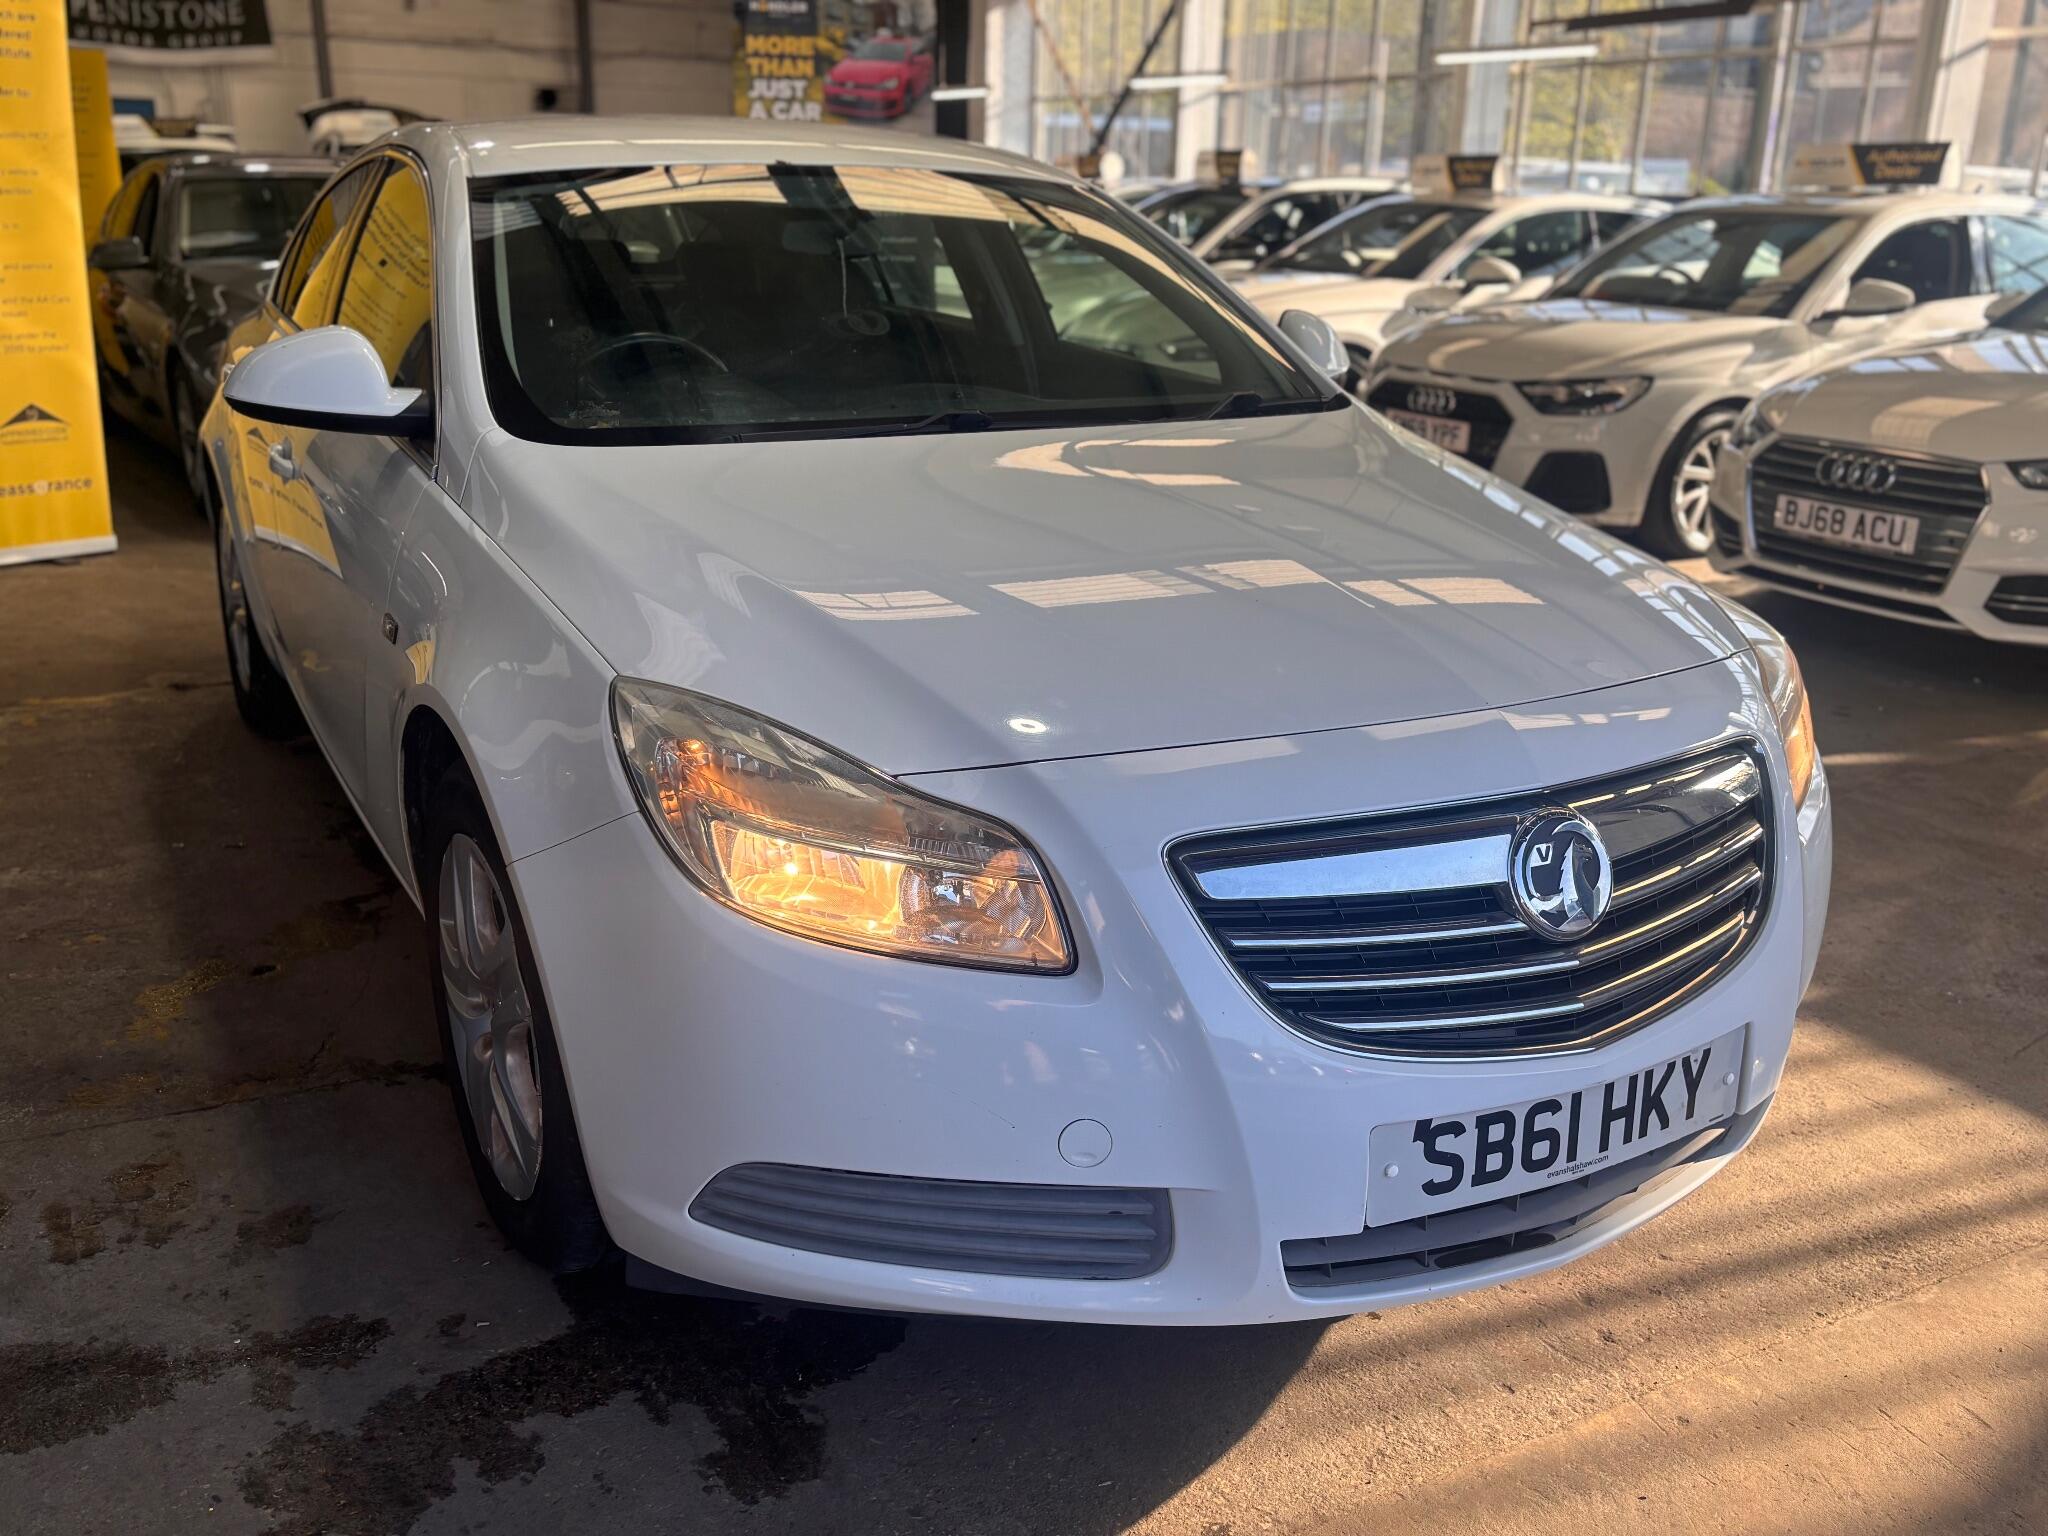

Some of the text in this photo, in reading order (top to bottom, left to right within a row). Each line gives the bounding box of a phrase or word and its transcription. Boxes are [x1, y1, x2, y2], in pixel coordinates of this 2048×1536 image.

[70, 0, 246, 30] PENISTONE
[745, 34, 815, 56] MORE
[746, 57, 815, 77] THAN
[747, 78, 808, 99] JUST
[748, 99, 823, 122] A CAR
[1783, 500, 1907, 546] BJ68 ACU
[1413, 1047, 1712, 1197] SB61 HKY
[1546, 1154, 1609, 1179] evanshalshaw.com
